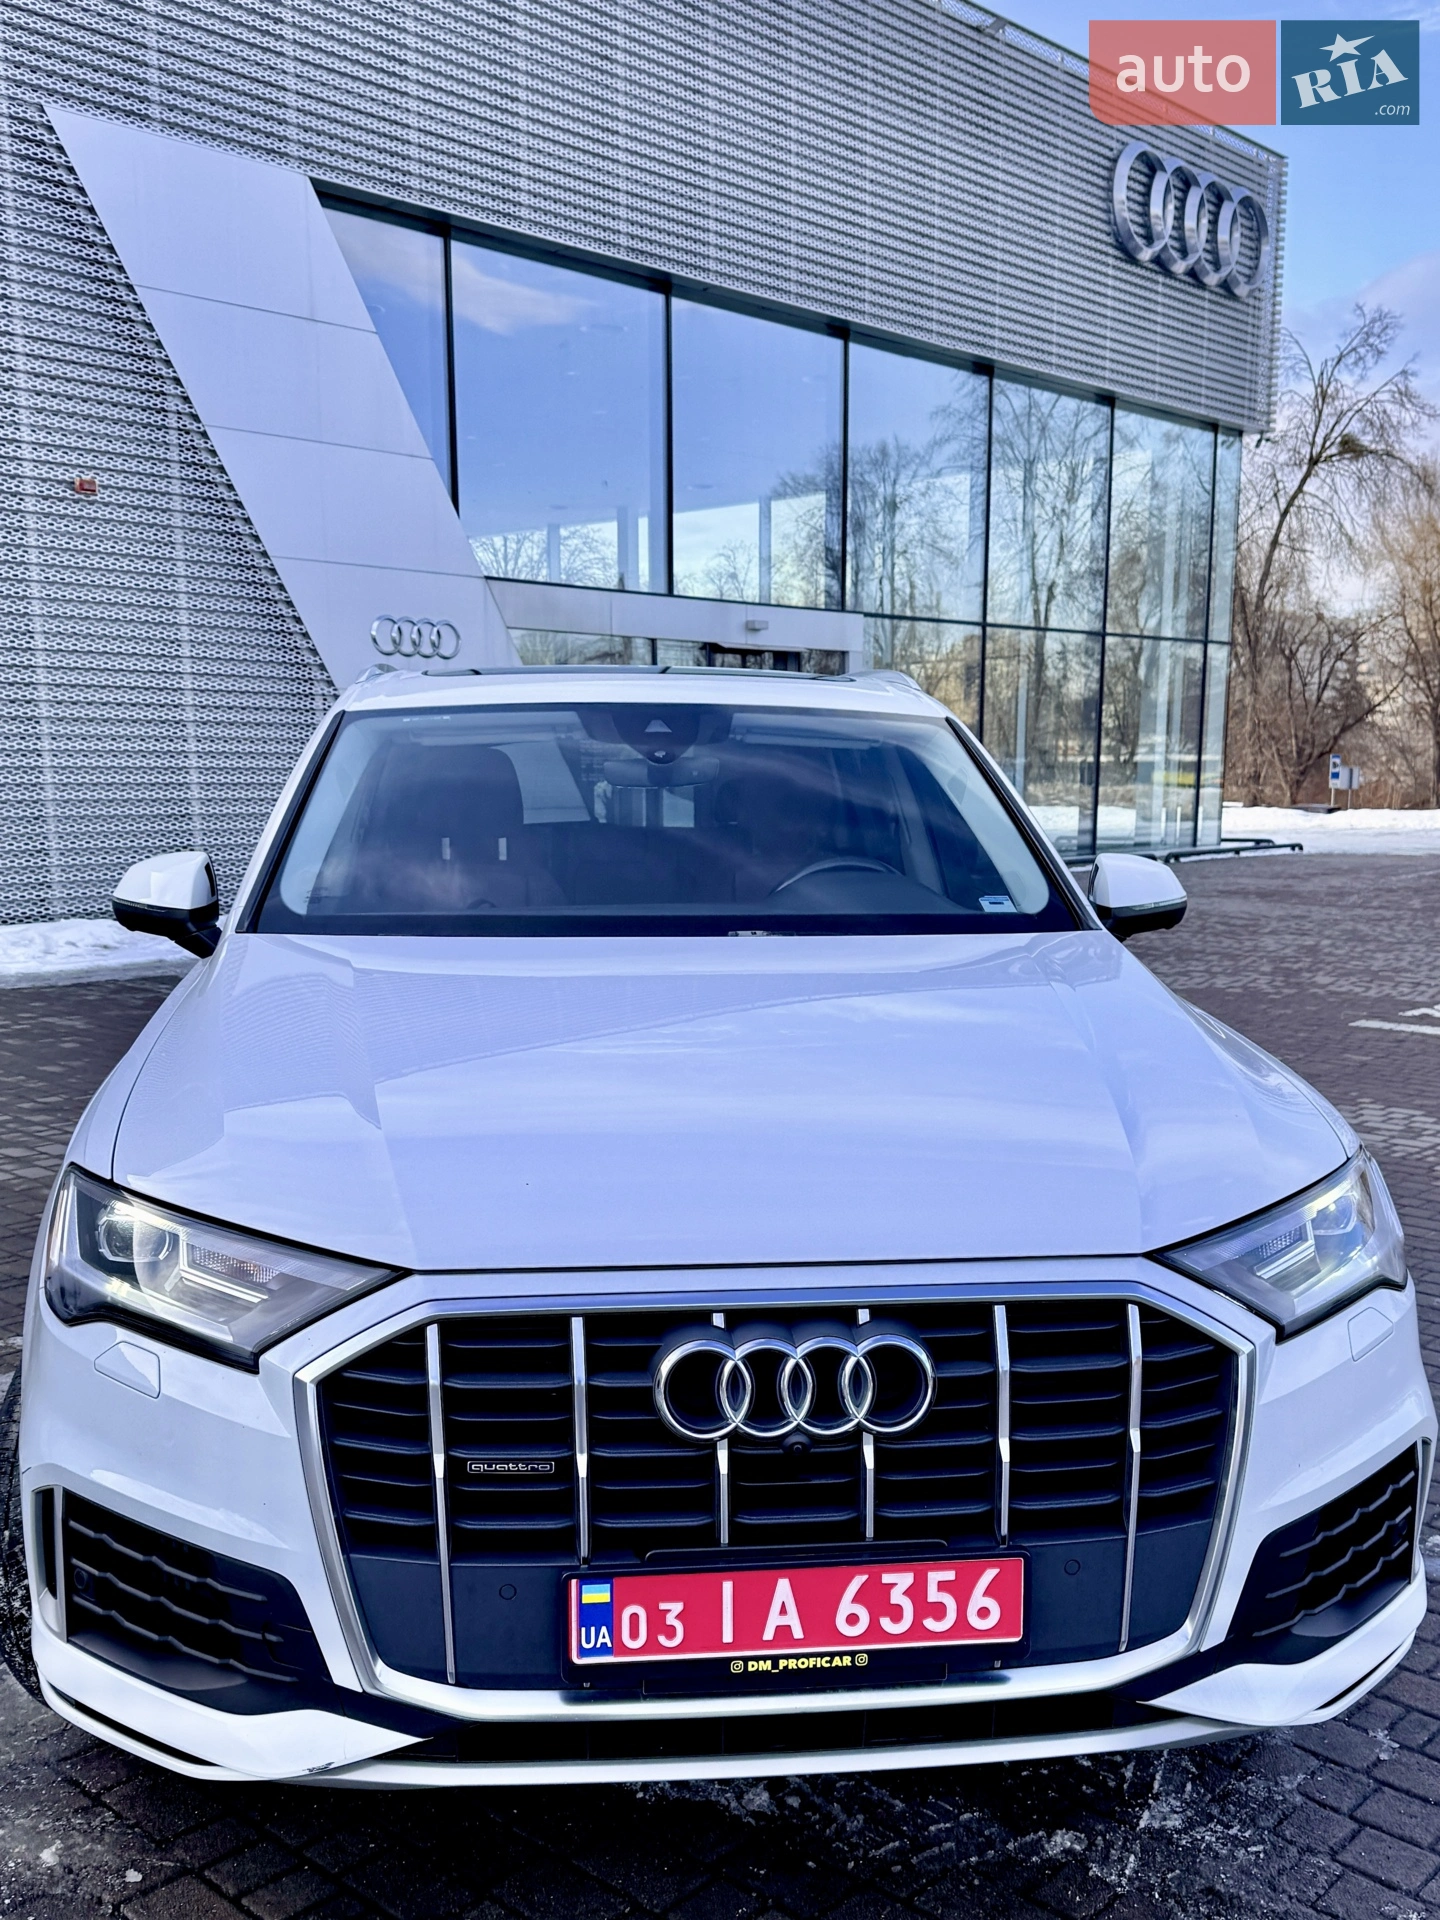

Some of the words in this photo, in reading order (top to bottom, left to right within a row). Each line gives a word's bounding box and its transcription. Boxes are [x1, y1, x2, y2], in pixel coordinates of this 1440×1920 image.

[471, 1463, 551, 1472] quattro
[581, 1625, 612, 1649] UA
[621, 1602, 685, 1649] 03
[835, 1568, 1001, 1638] 6356
[748, 1656, 852, 1673] DM_PROFICAR
